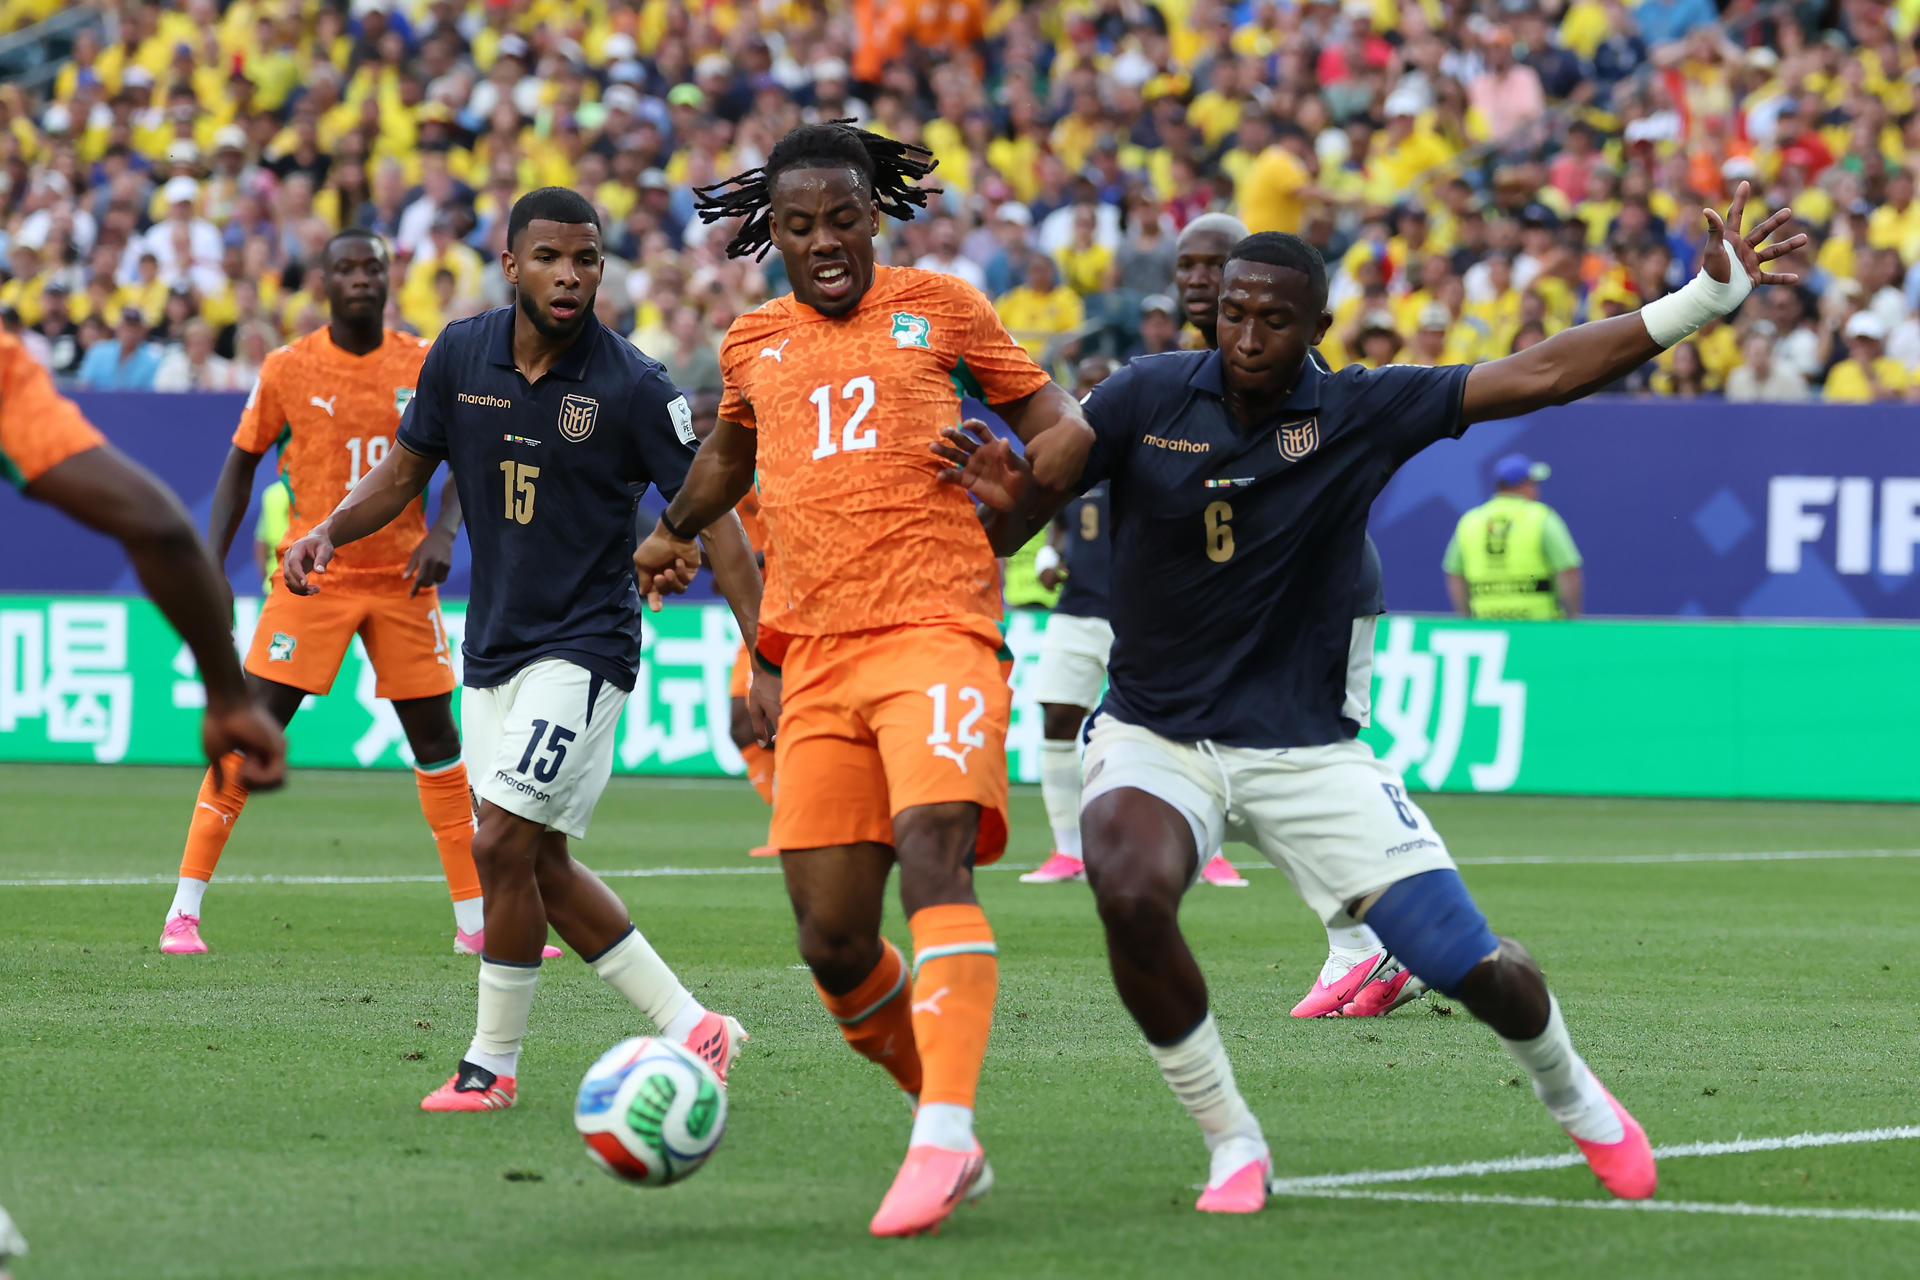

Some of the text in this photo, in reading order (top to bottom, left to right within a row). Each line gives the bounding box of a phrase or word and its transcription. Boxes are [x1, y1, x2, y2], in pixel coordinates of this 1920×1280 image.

[457, 393, 511, 409] marathon
[808, 375, 877, 461] 12
[1143, 433, 1210, 453] marathon
[500, 460, 540, 525] 15
[1204, 501, 1235, 562] 6
[926, 683, 984, 748] 12
[516, 719, 577, 783] 15
[495, 770, 551, 803] marathon
